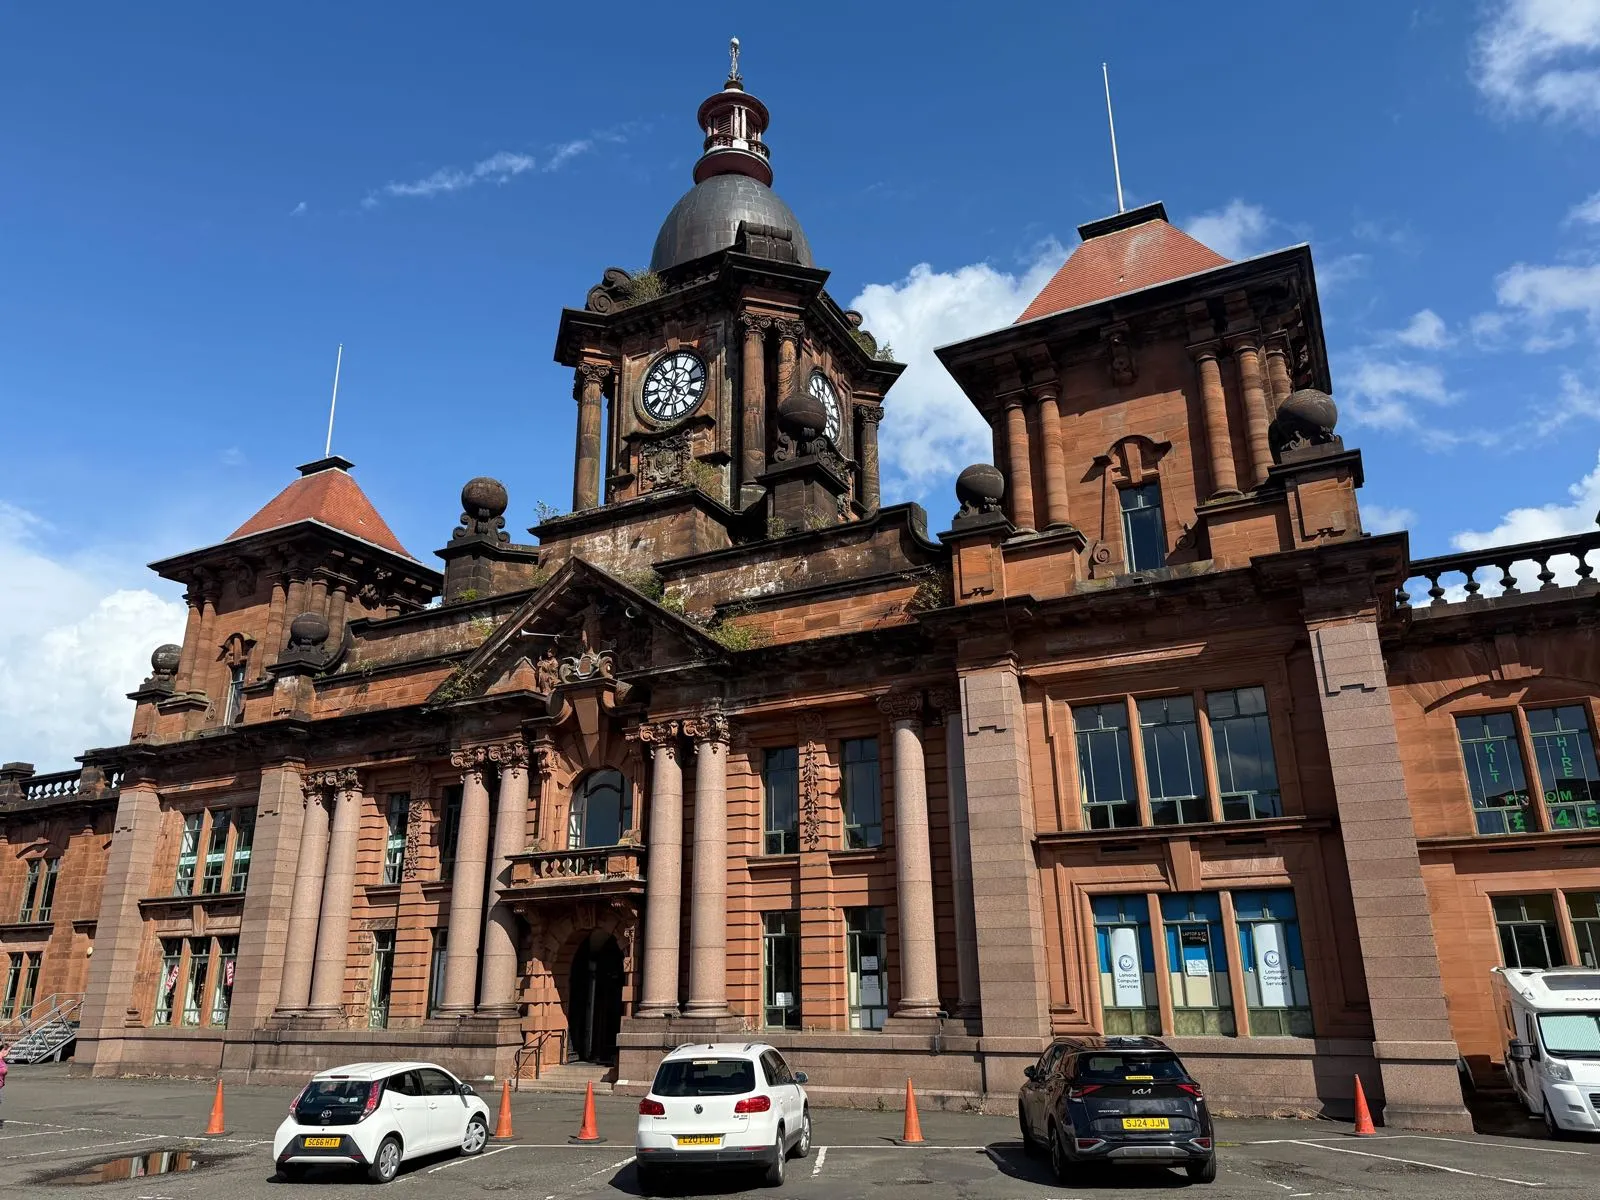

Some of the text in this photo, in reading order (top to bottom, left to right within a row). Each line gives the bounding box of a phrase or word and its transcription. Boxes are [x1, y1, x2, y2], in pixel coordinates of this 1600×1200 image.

[1485, 743, 1500, 783] KILT
[1557, 737, 1574, 777] HIRE
[1126, 1119, 1148, 1128] SJ24
[308, 1138, 339, 1146] SC66 HTT
